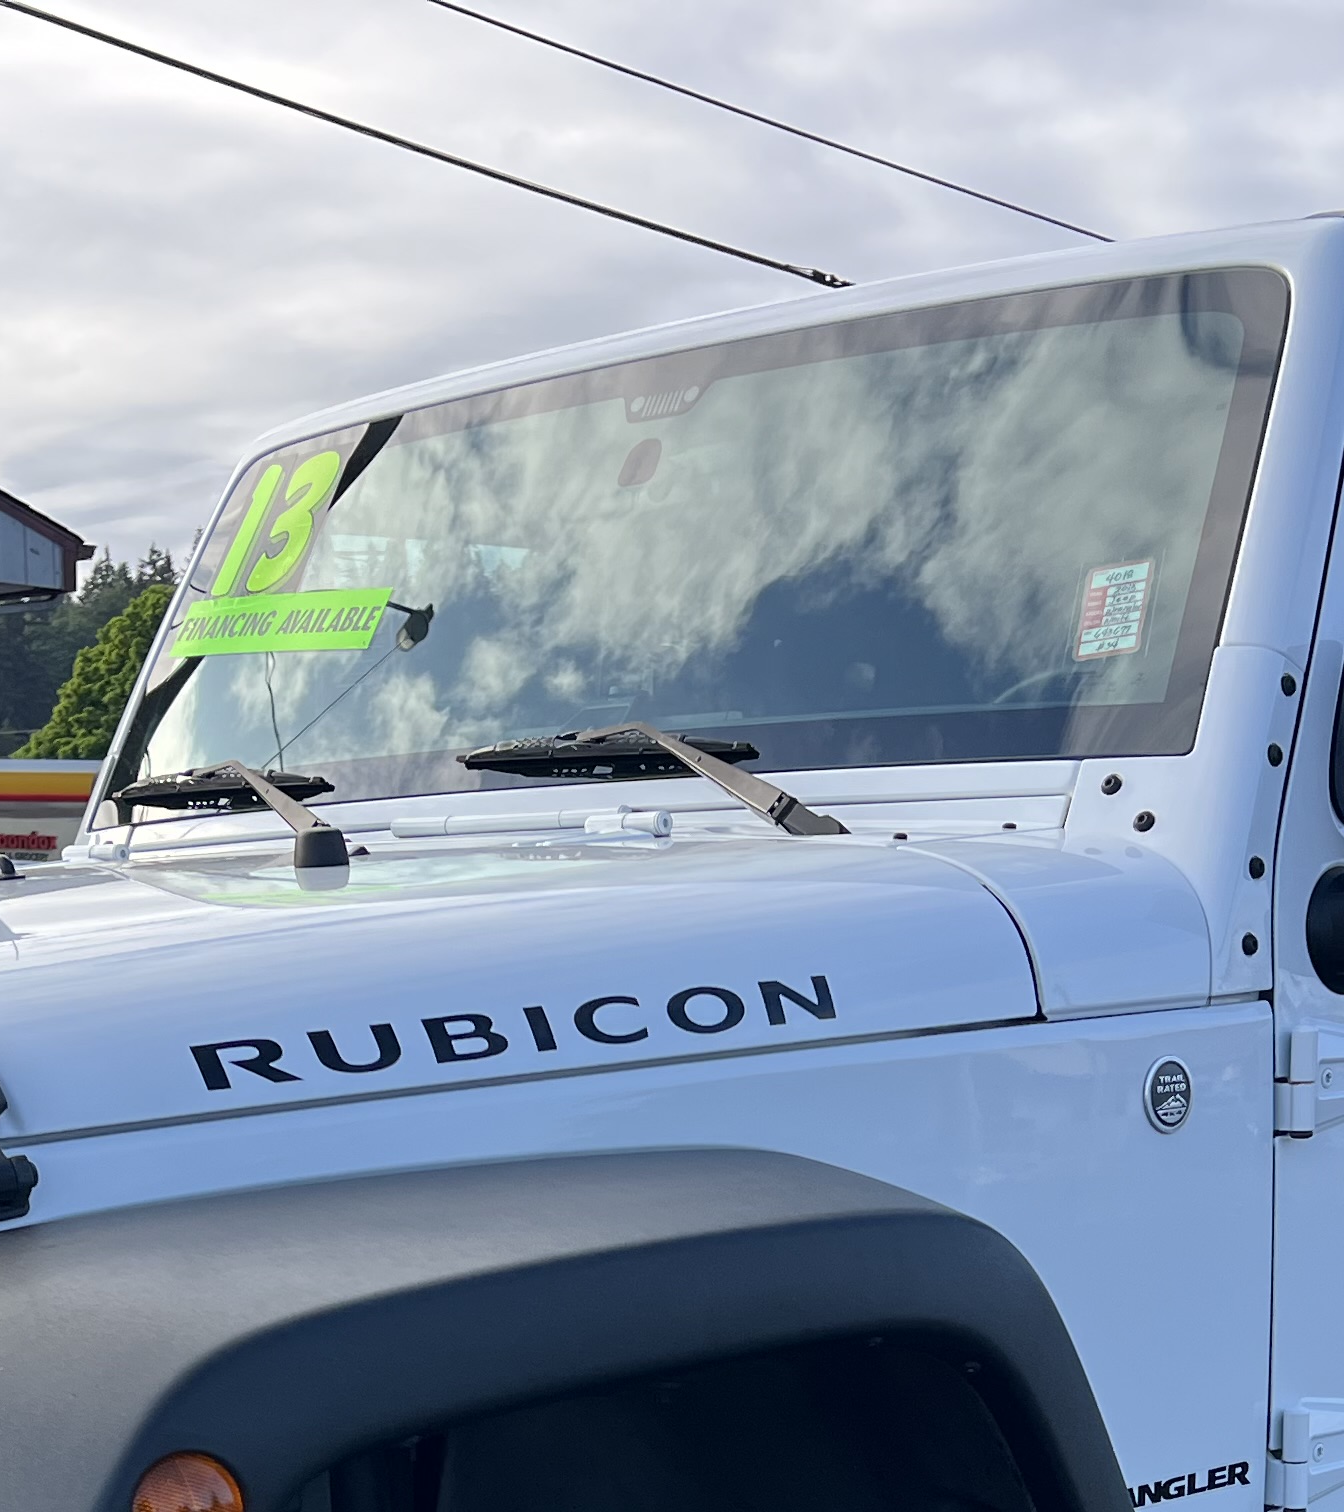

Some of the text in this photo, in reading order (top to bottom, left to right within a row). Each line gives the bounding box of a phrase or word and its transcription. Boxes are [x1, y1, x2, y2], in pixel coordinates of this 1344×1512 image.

[211, 451, 341, 598] 13
[177, 605, 382, 642] FINANCING AVAILABLE
[189, 975, 837, 1091] RUBICON
[1157, 1083, 1187, 1093] RATED
[1158, 1073, 1184, 1084] TRAIL
[1127, 1461, 1251, 1508] NGLER
